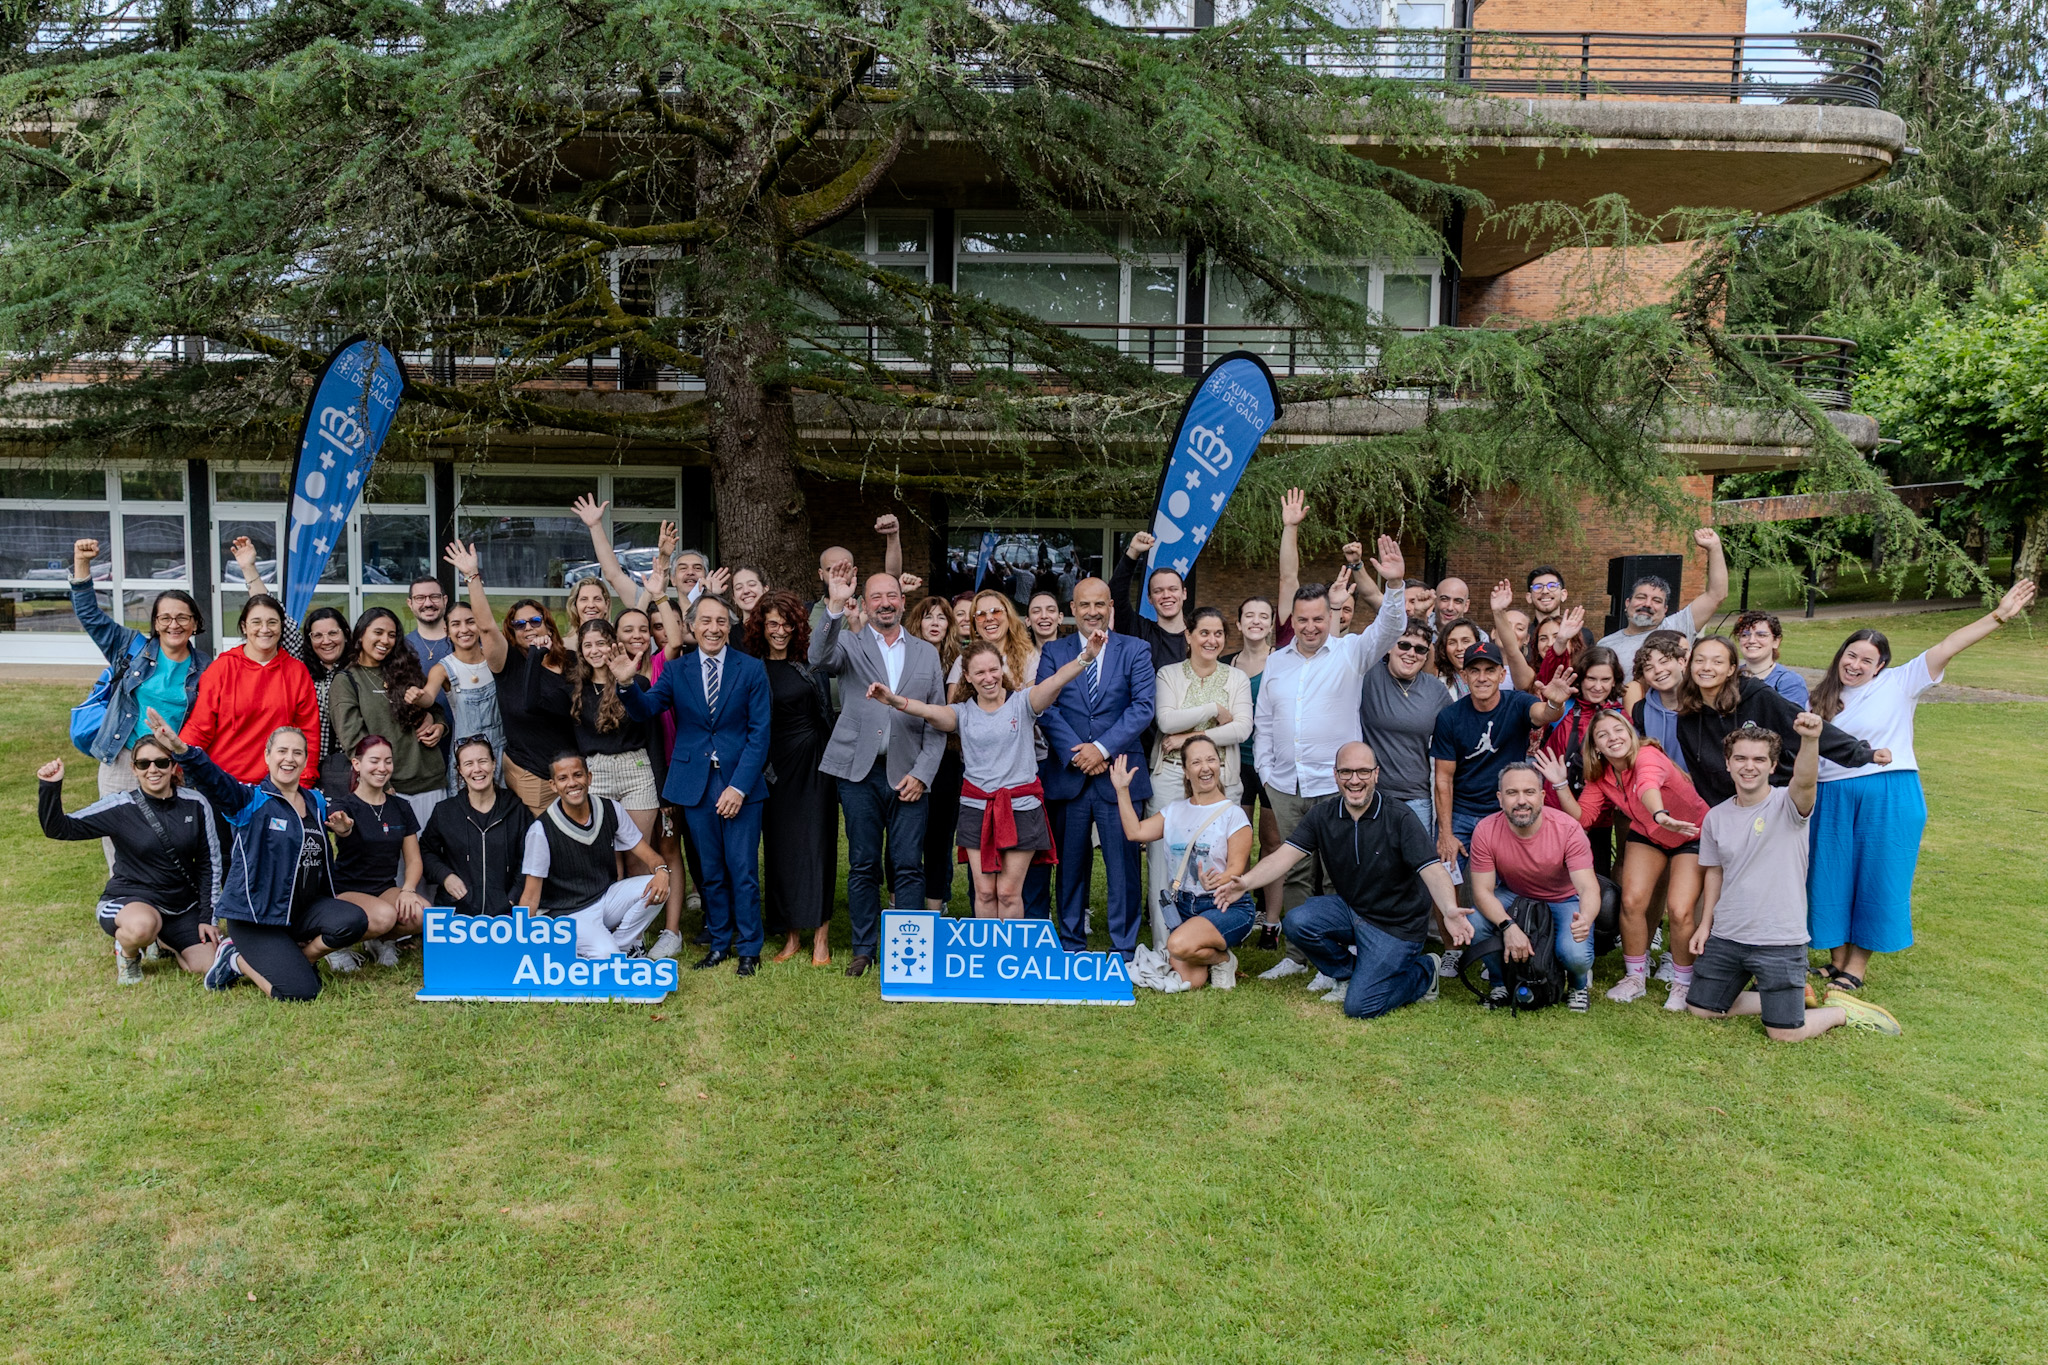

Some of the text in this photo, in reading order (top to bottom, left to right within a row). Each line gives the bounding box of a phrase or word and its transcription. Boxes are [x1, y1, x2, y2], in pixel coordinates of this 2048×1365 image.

[368, 384, 394, 412] ALIC
[1222, 391, 1237, 407] DE
[1228, 380, 1259, 411] XUNTA
[151, 821, 172, 848] PRUN
[426, 911, 572, 944] Escolas
[947, 923, 1057, 949] XUNTA
[512, 953, 674, 986] Abertas
[945, 954, 1126, 982] DE GALICIA
